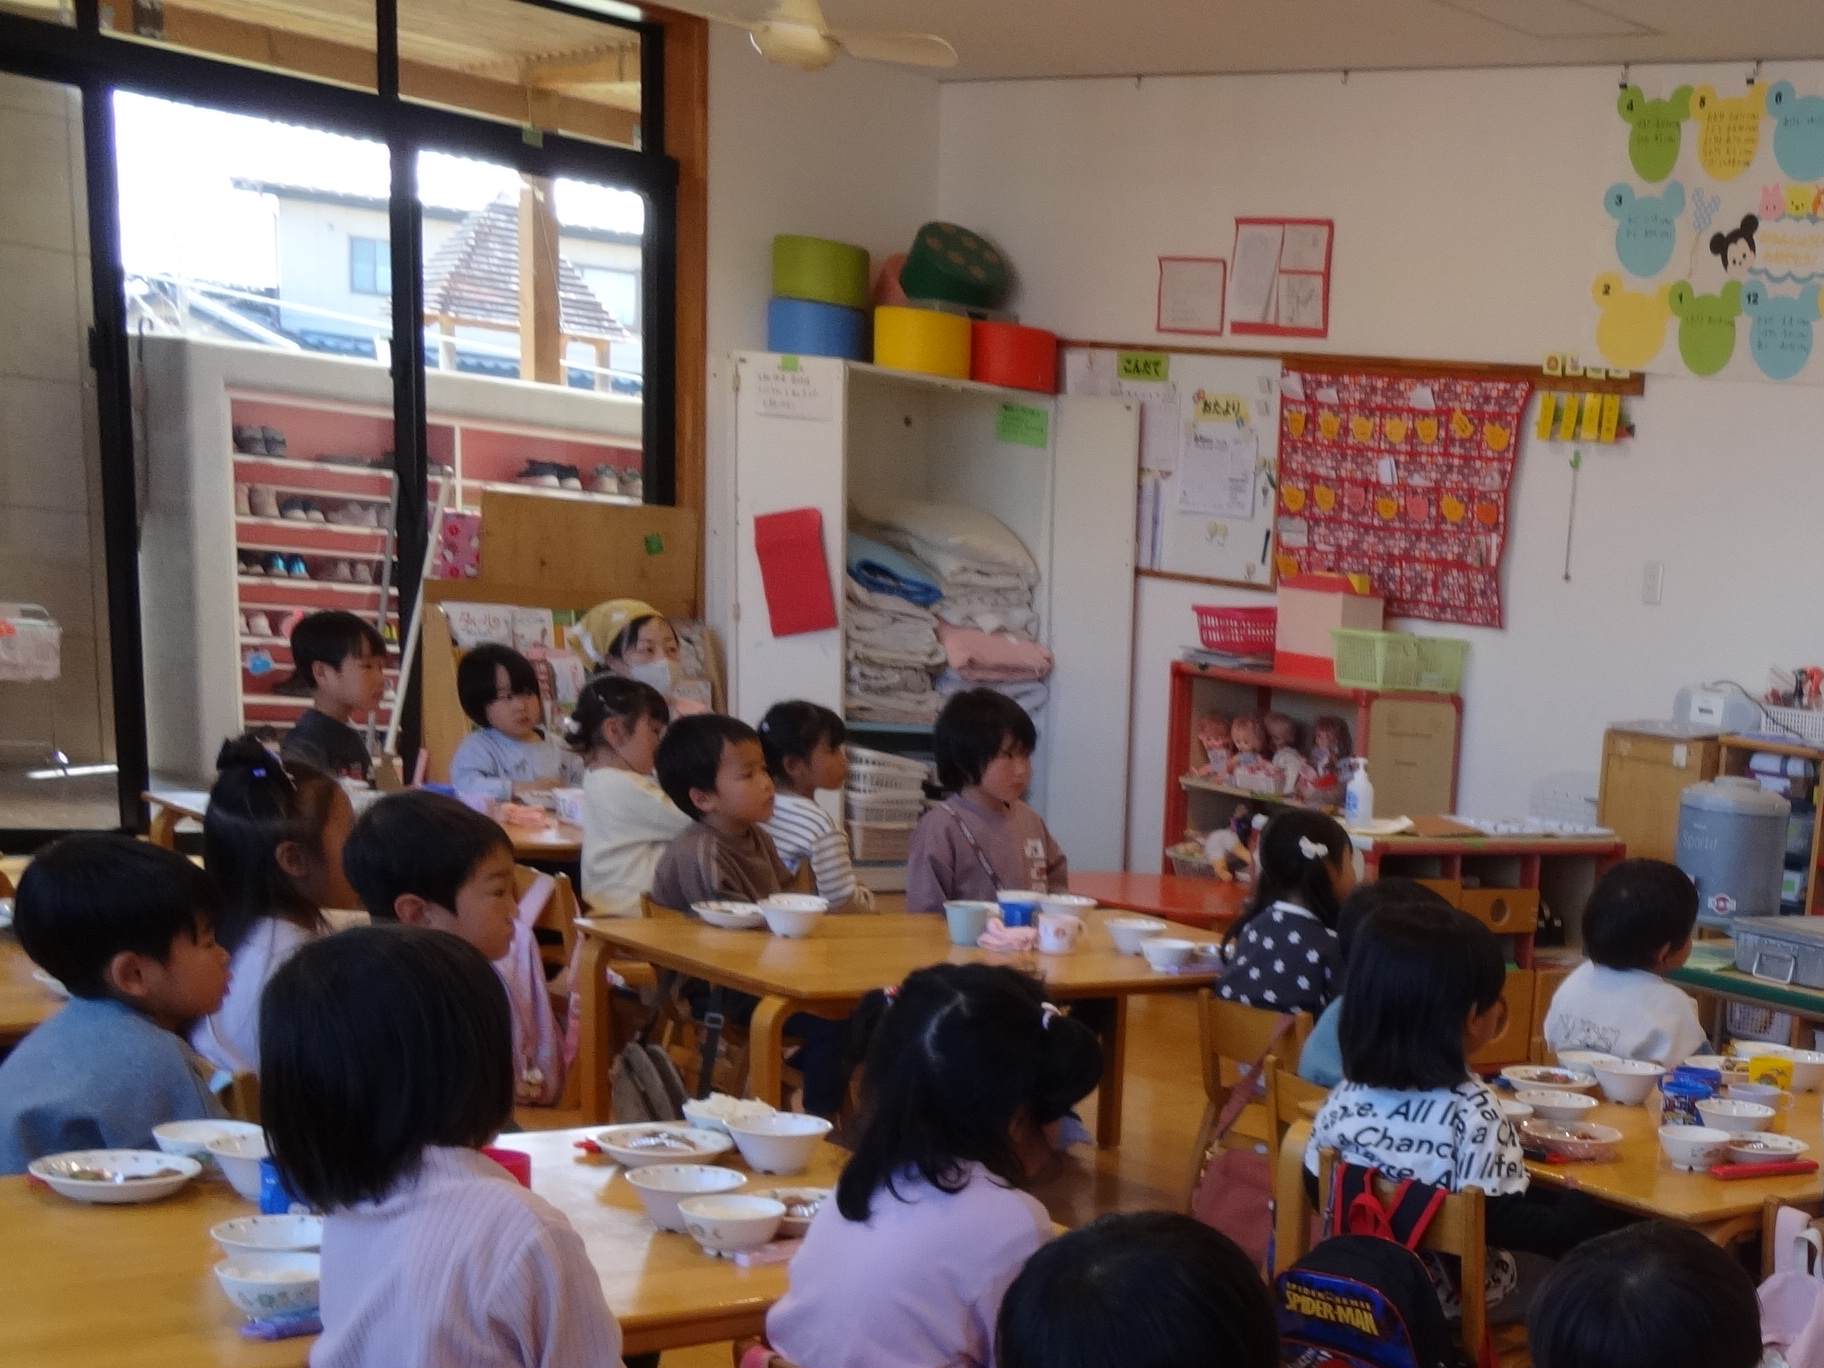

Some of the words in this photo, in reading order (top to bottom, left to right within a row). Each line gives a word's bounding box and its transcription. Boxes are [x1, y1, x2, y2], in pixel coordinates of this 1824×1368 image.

[1774, 90, 1782, 104] 6
[1615, 194, 1623, 207] 3
[1602, 283, 1611, 296] 2
[1746, 291, 1759, 305] 12
[1123, 358, 1162, 377] こんだて
[1201, 397, 1241, 417] おたより
[1386, 1098, 1436, 1124] All
[1284, 1288, 1380, 1337] SPIDER-MAN
